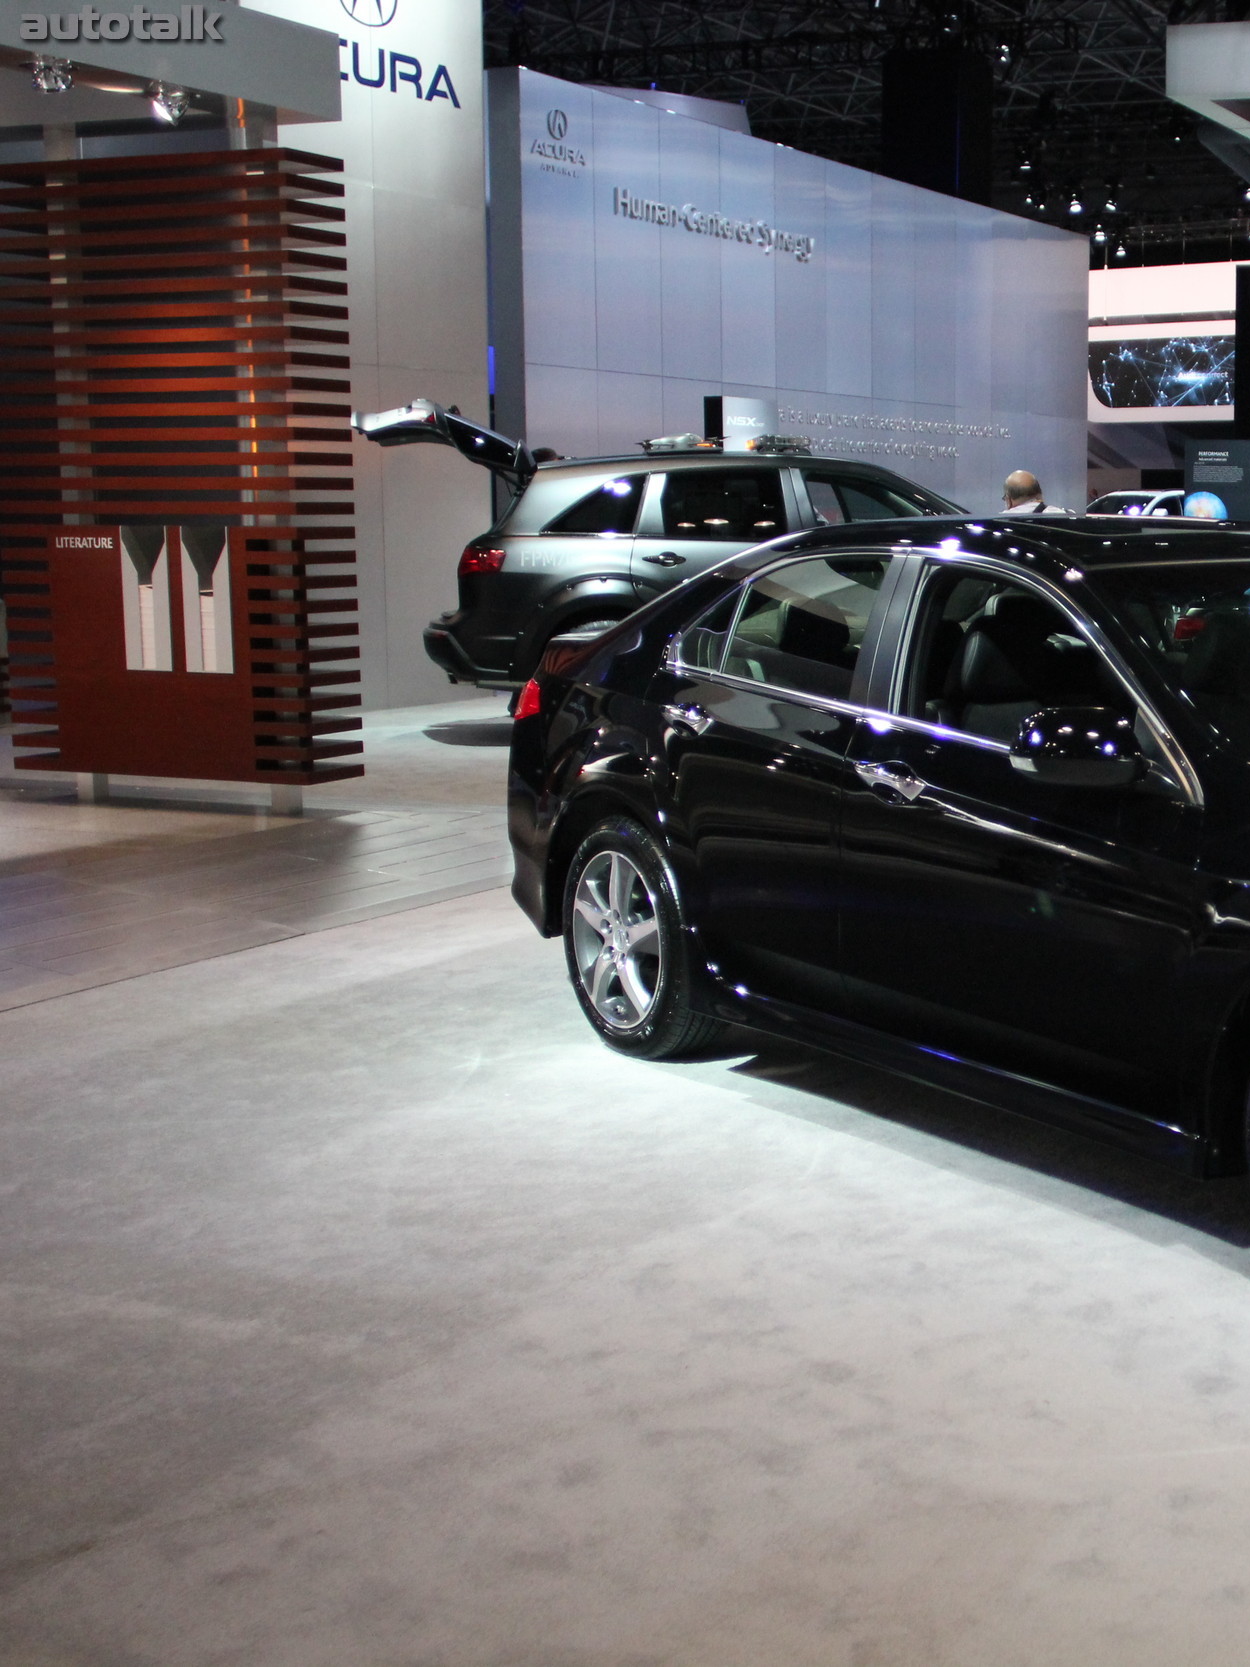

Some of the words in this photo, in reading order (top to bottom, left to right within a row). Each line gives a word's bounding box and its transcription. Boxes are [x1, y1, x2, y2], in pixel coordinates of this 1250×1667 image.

[530, 140, 586, 166] ACURA
[757, 220, 815, 262] Synergy
[727, 416, 756, 427] NSX
[55, 536, 114, 549] LITERATURE
